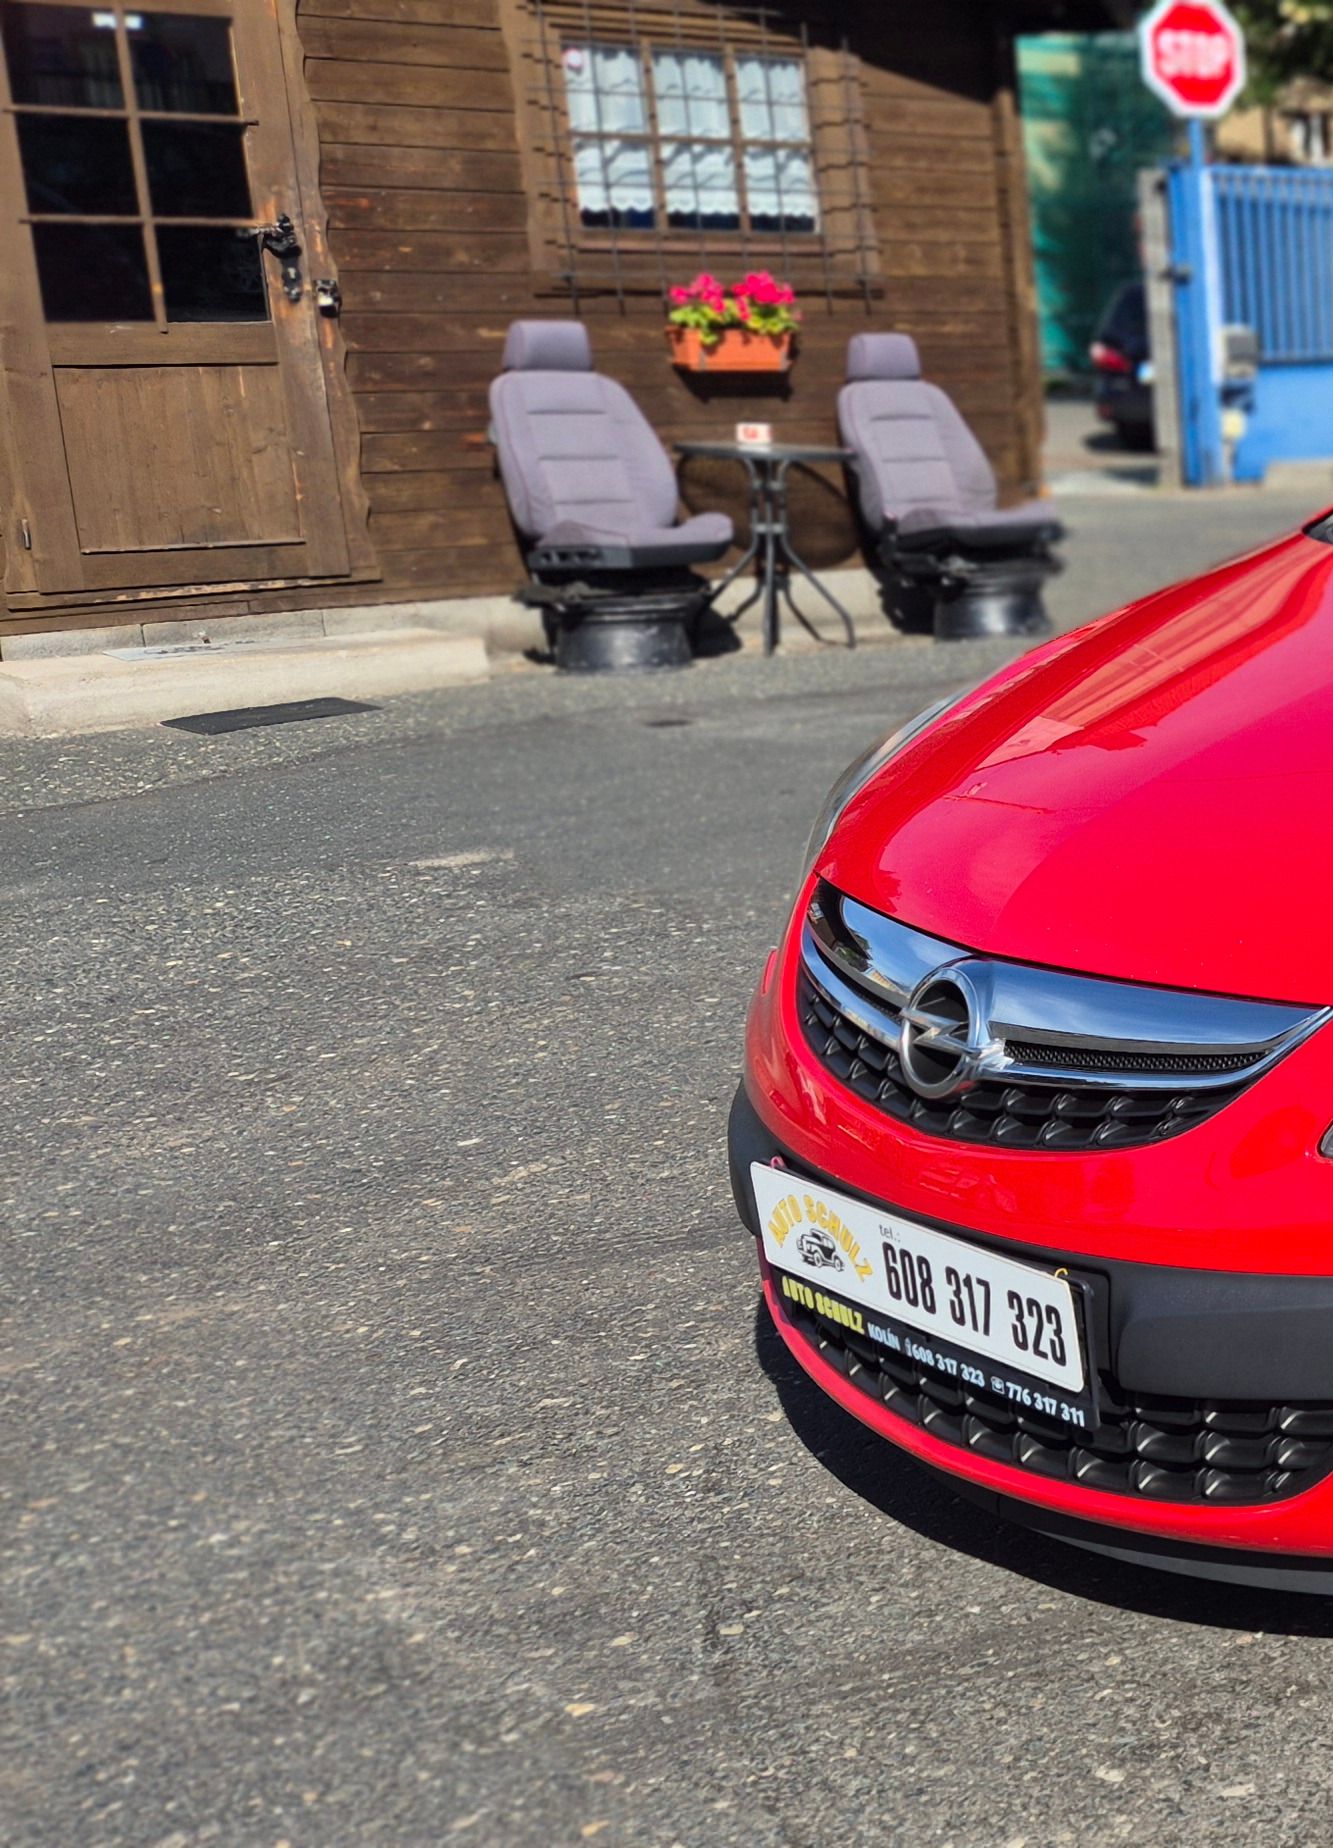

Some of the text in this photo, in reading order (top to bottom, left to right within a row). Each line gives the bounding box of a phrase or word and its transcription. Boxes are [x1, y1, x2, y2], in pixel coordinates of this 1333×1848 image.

[1158, 30, 1228, 79] STOP
[767, 1193, 874, 1283] AUTO SCHULZ
[782, 1275, 815, 1310] AUTO
[814, 1291, 865, 1336] SCHULZ
[913, 1342, 936, 1367] 608
[935, 1352, 959, 1376] 317
[960, 1363, 986, 1388] 323
[1006, 1381, 1032, 1407] 776
[1033, 1391, 1057, 1416] 317
[1060, 1402, 1086, 1428] 311
[882, 1241, 1067, 1367] 608 317 323
